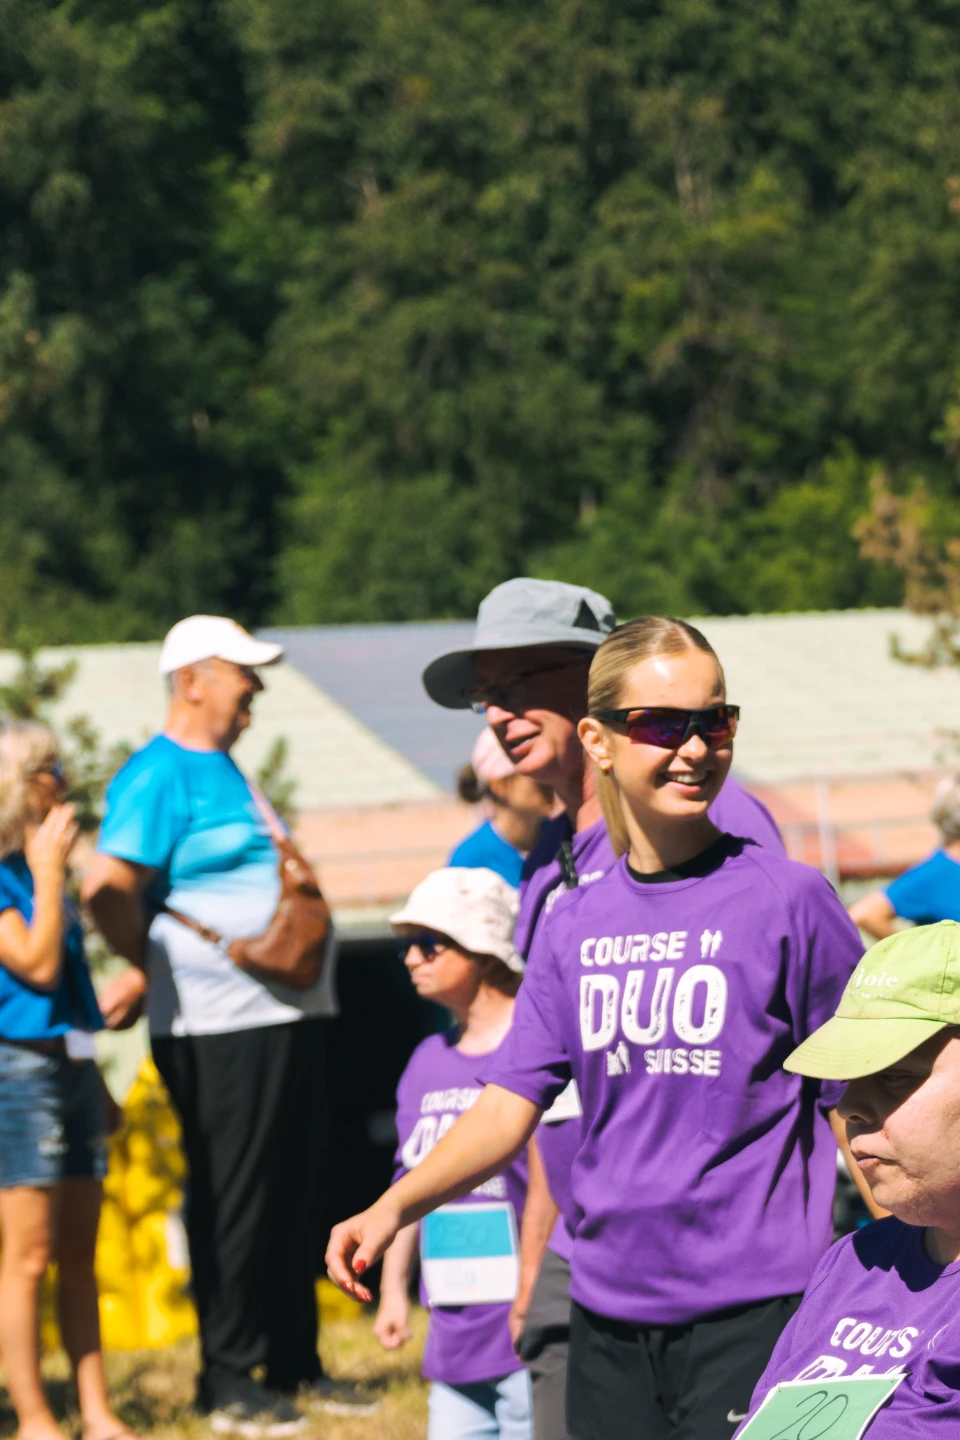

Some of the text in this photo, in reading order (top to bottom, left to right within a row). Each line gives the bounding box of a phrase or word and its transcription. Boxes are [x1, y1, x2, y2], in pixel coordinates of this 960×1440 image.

[580, 930, 688, 967] COURSE
[579, 964, 728, 1052] DUO
[644, 1048, 722, 1077] SUISSE
[830, 1317, 919, 1358] COURS
